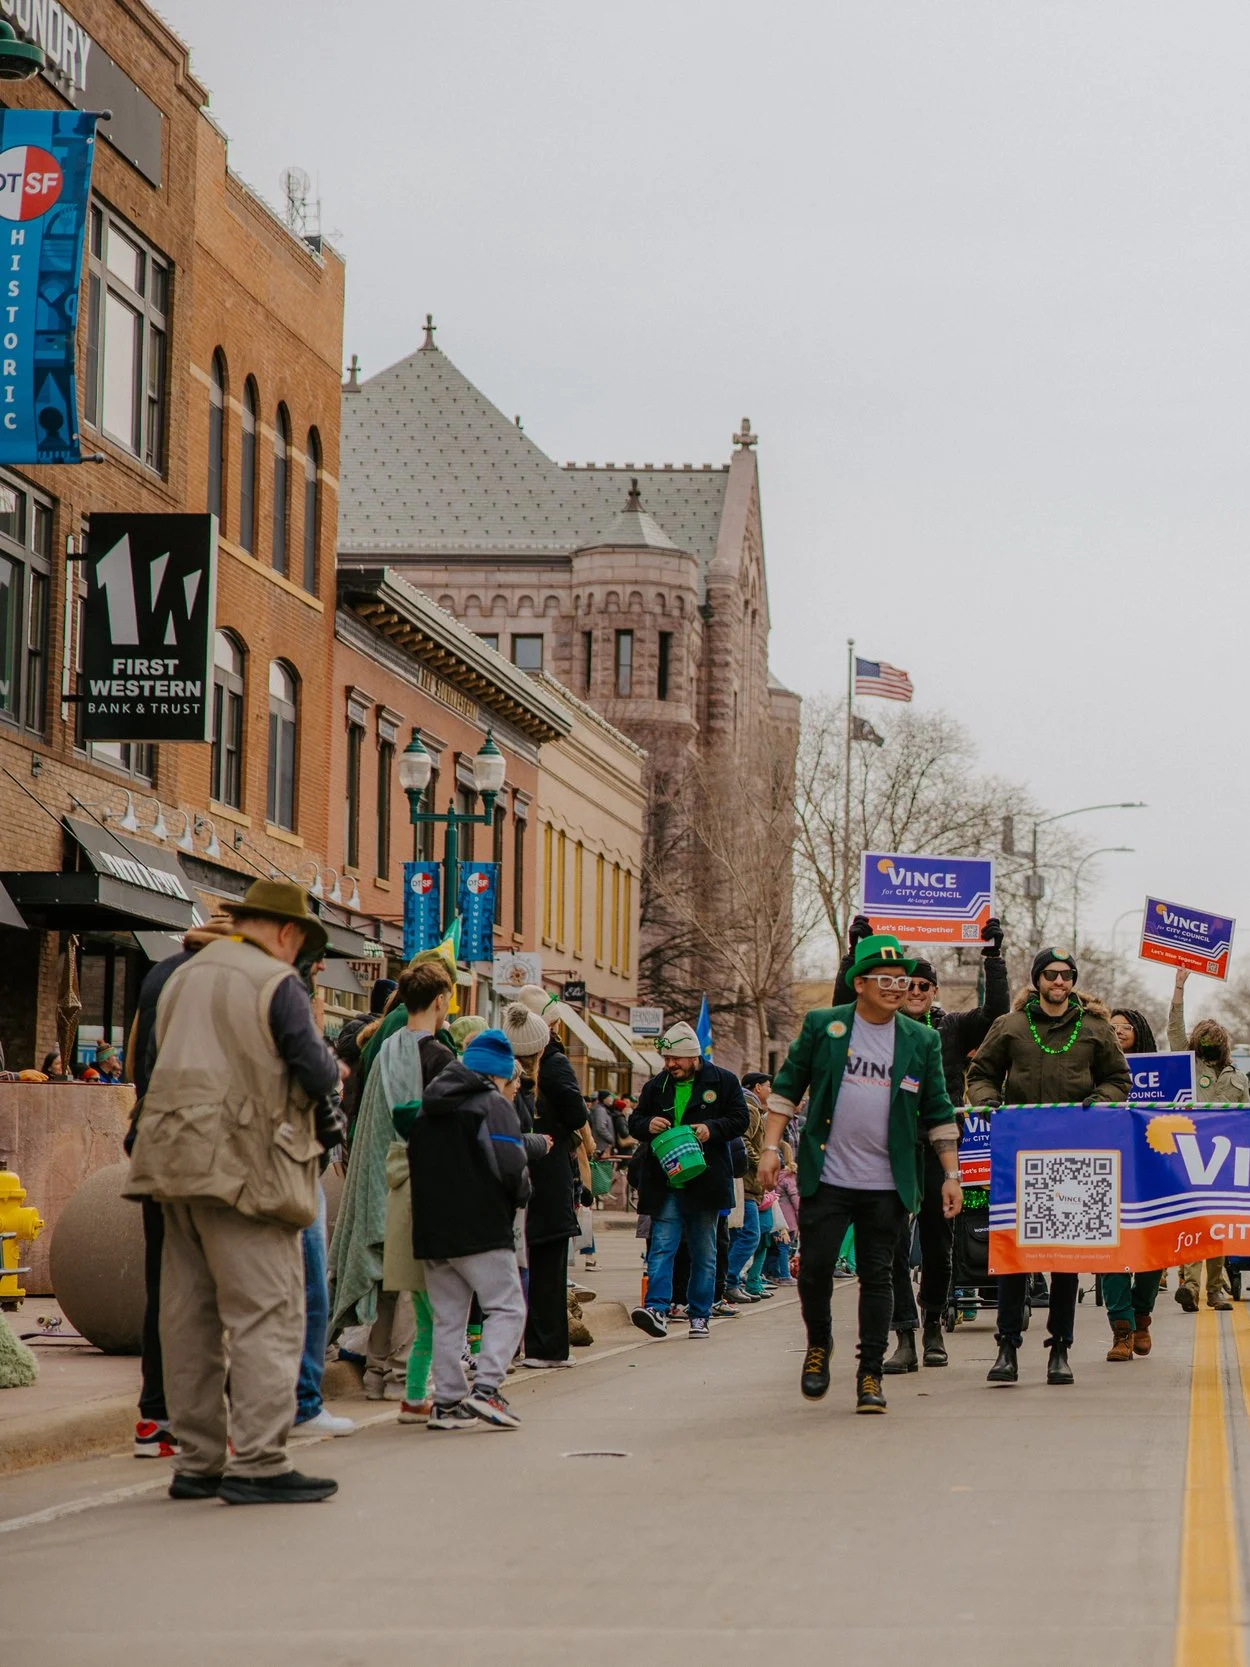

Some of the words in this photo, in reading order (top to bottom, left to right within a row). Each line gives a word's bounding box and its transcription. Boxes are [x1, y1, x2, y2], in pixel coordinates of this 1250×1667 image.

[3, 229, 25, 430] HISTORIC
[112, 658, 179, 676] FIRST
[89, 679, 201, 697] WESTERN
[88, 703, 131, 714] BANK
[136, 703, 145, 714] &
[150, 703, 201, 714] TRUST
[887, 867, 957, 889] VINCE
[881, 888, 893, 896] for
[895, 888, 917, 897] CITY
[919, 889, 962, 899] COUNCIL
[876, 924, 897, 932] Let's
[917, 925, 954, 935] Together
[1161, 910, 1209, 935] VINCE
[1165, 926, 1181, 935] CITY
[1181, 930, 1211, 943] COUNCIL
[972, 1134, 990, 1142] CITY
[1058, 1194, 1081, 1203] VINCE
[1173, 1230, 1202, 1253] for
